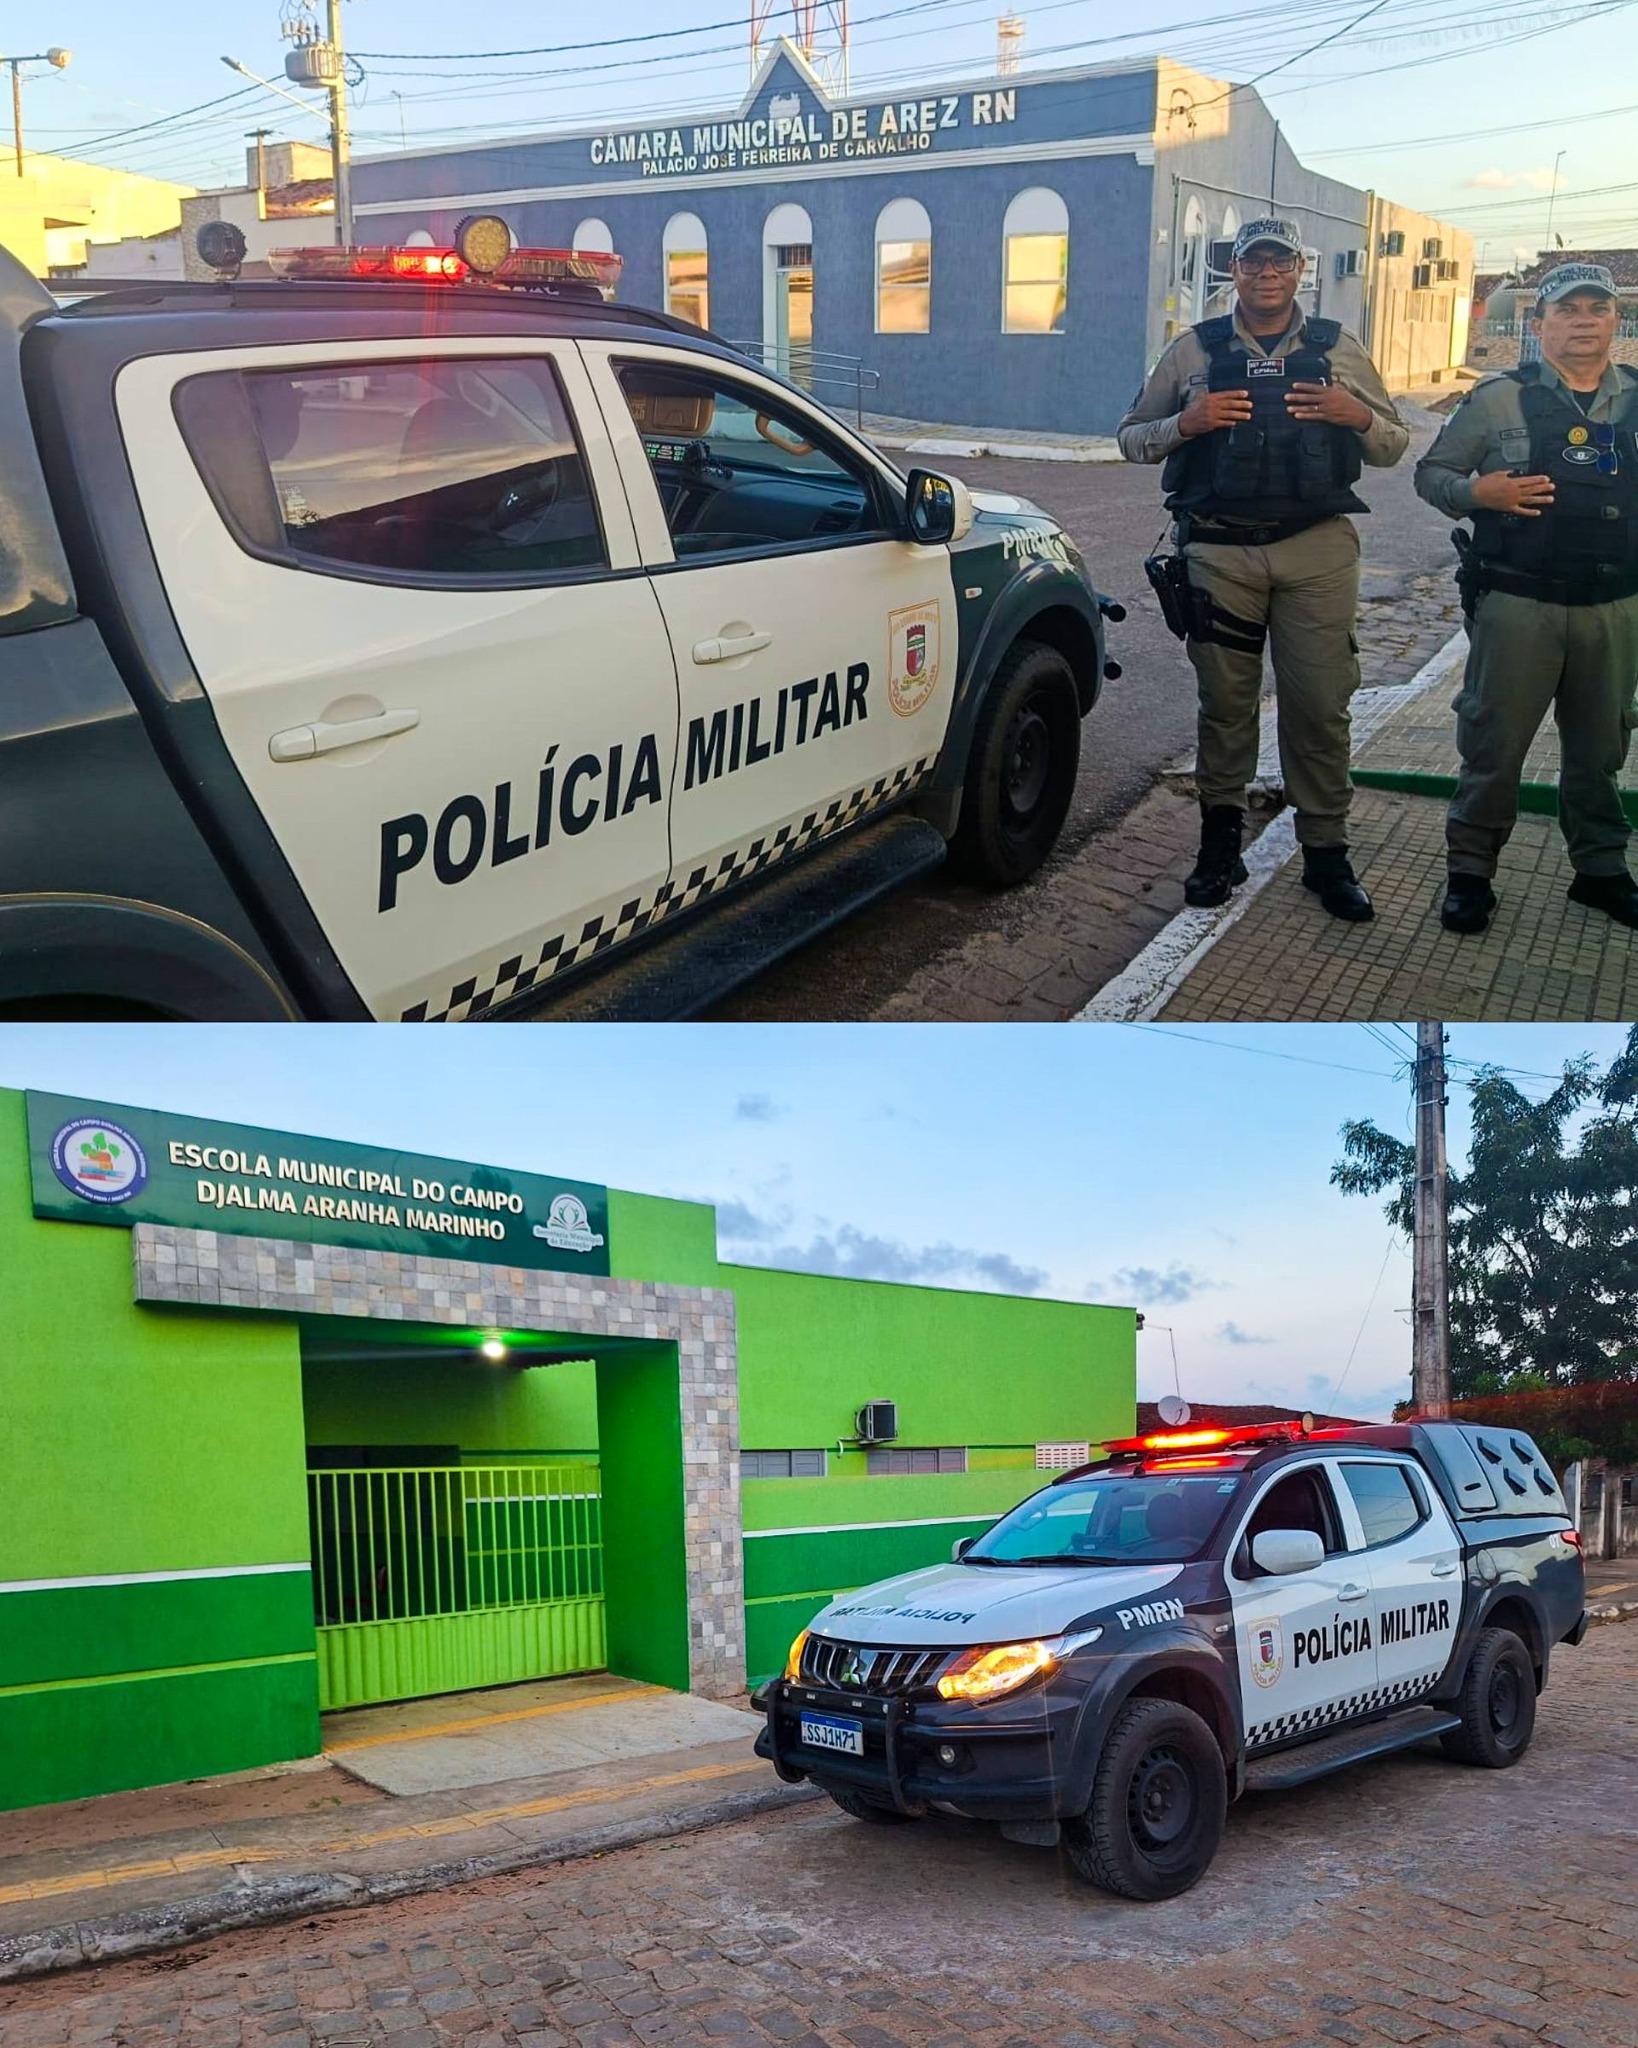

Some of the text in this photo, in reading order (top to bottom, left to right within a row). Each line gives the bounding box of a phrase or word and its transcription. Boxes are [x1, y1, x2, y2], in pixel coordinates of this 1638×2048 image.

[590, 90, 1016, 164] CÂMARA MUNICIPAL DE AREZ RN
[642, 155, 698, 176] PALACIO
[742, 147, 812, 166] FERREIRA
[819, 142, 839, 159] DE
[844, 133, 930, 156] CARVALHO
[378, 662, 870, 913] POLÍCIA MILITAR
[168, 1141, 272, 1178] ESCOLA
[278, 1157, 407, 1197] MUNICIPAL
[412, 1178, 445, 1202] DO
[450, 1184, 523, 1214] CAMPO
[197, 1180, 505, 1240] DJALMA ARANHA MARINHO
[1116, 1597, 1185, 1631] PMRN
[1293, 1599, 1450, 1668] POLÍCIA MILITAR
[807, 1724, 857, 1751] SSJ1H71
